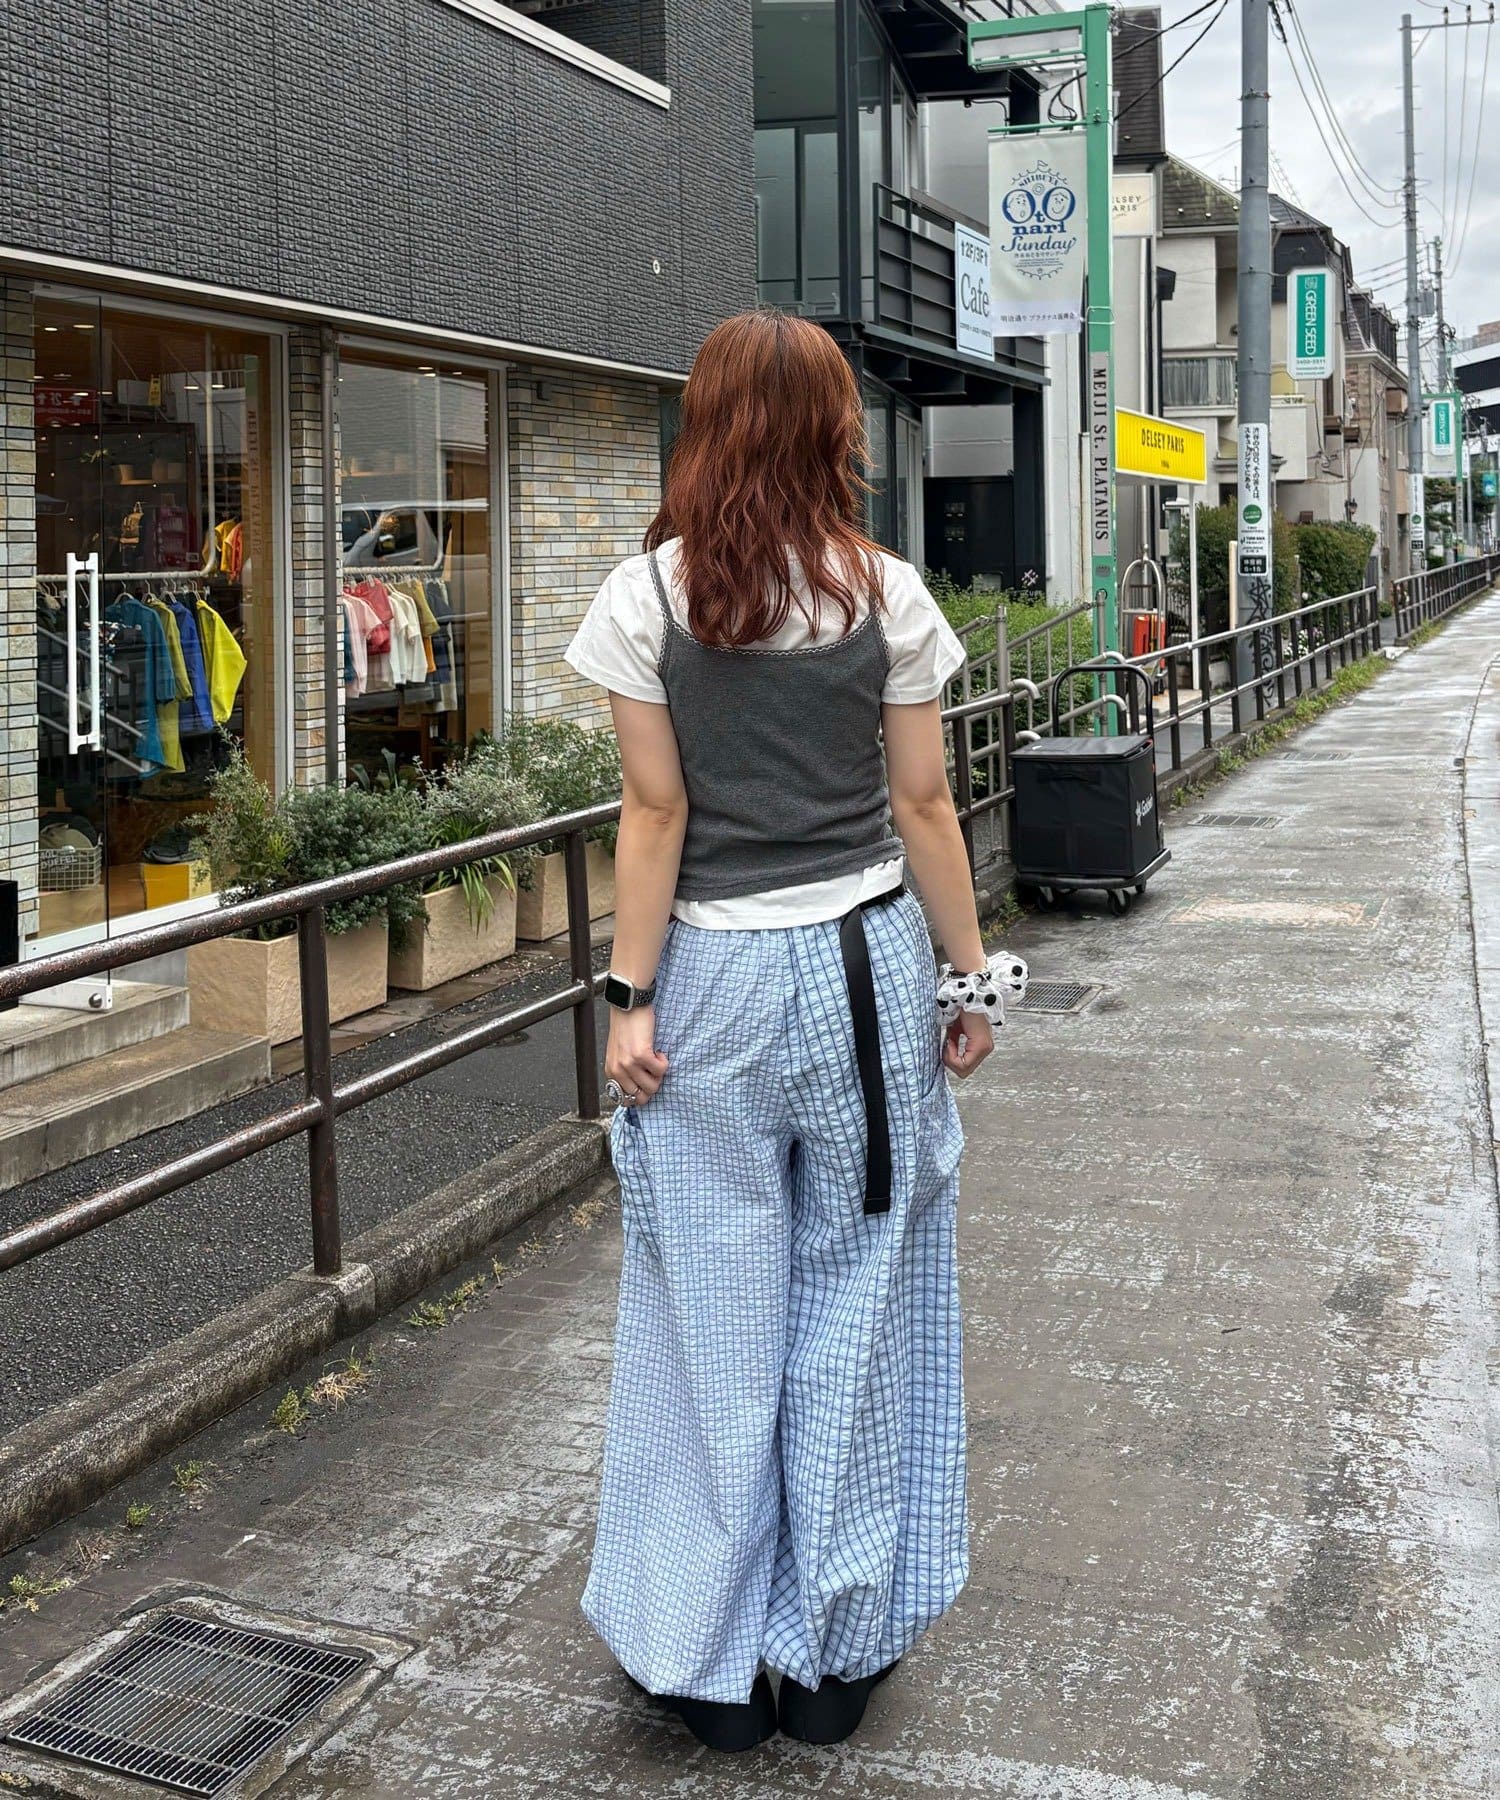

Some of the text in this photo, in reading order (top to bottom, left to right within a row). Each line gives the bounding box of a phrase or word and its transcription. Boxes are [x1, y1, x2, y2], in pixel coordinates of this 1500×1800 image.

[1001, 234, 1078, 254] Sunday
[1012, 220, 1067, 236] nari
[960, 272, 990, 318] Cafe
[1305, 290, 1317, 356] GREEN SEED
[1093, 368, 1109, 540] MEIJI St. PLATANUS
[1141, 428, 1185, 454] DELSEY PARIS
